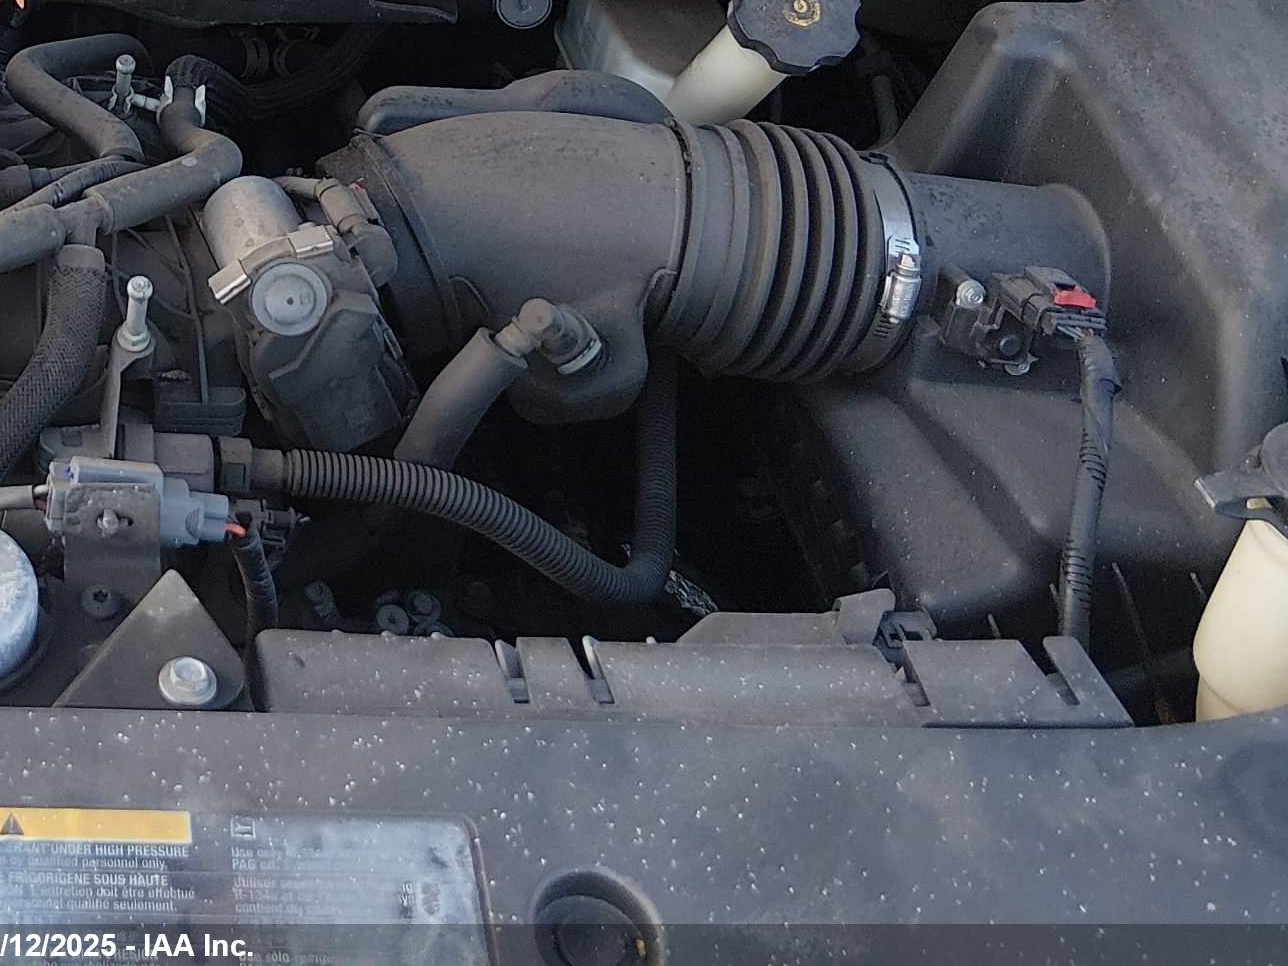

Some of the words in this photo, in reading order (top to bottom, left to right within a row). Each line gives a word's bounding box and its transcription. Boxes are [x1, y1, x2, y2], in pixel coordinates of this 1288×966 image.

[51, 843, 92, 856] UNDER
[95, 844, 124, 856] HIGH
[127, 844, 189, 857] PRESSURE
[94, 873, 127, 885] SOUS
[129, 874, 168, 886] HAUTE
